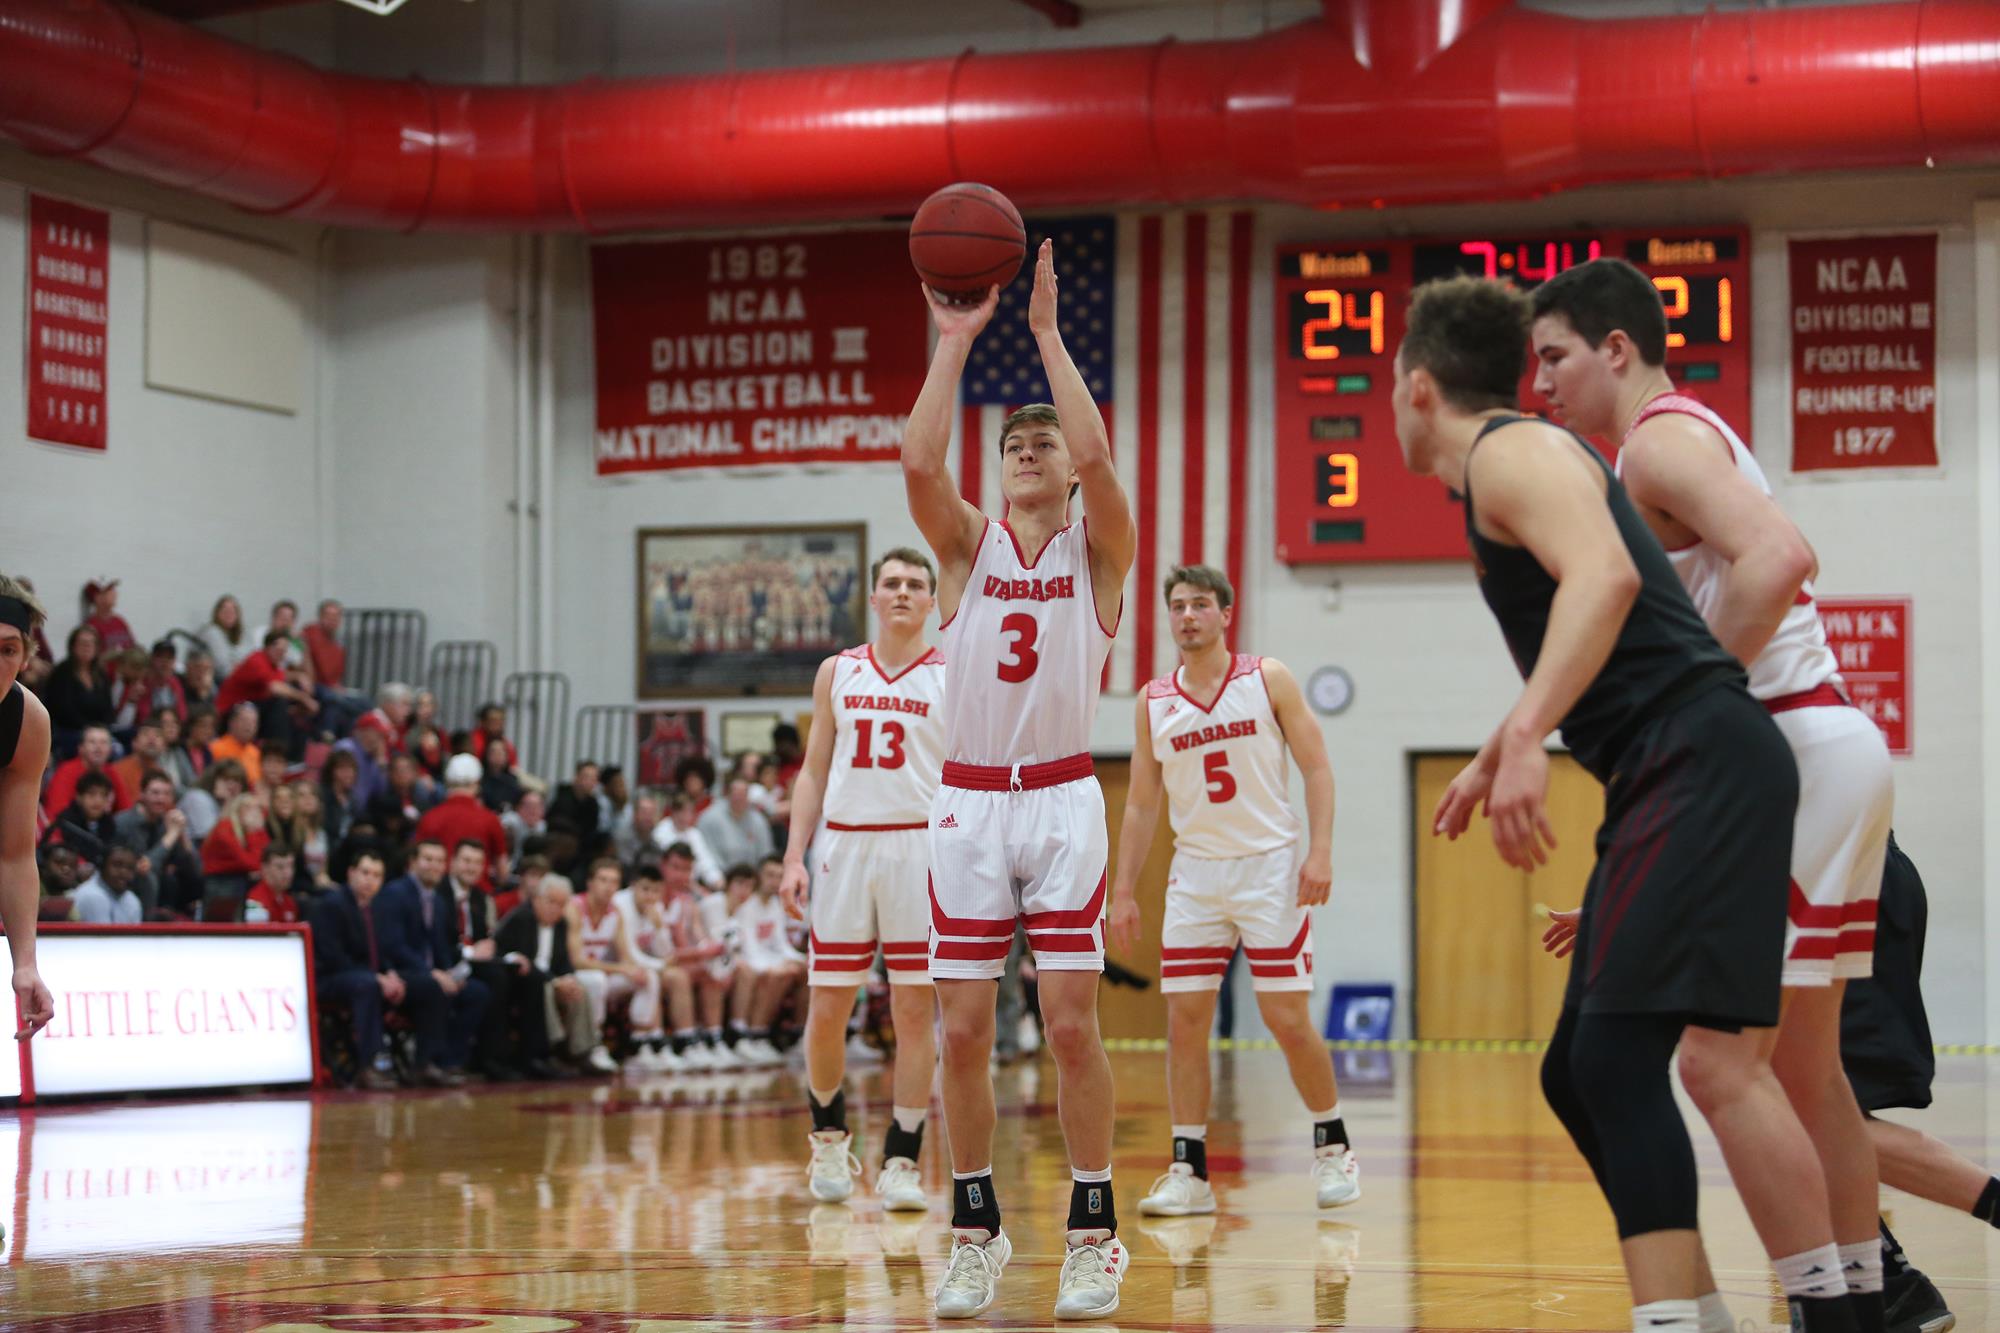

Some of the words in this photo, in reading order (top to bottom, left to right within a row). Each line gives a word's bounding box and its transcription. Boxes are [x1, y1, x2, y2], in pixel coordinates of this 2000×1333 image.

[709, 248, 806, 280] 1982
[1816, 255, 1909, 293] NCAA
[34, 288, 106, 324] BASKETBALL
[709, 289, 804, 324] NCAA
[1302, 289, 1384, 360] 24
[1651, 275, 1732, 348] 21
[1795, 304, 1905, 333] DIVISION
[1909, 302, 1931, 329] III
[41, 326, 103, 356] MIDWEST
[651, 330, 813, 372] DIVISION
[833, 328, 868, 361] III
[1803, 344, 1921, 374] FOOTBALL
[645, 370, 874, 416] BASKETBALL
[1796, 385, 1937, 415] RUNNER-UP
[596, 420, 743, 463] NATIONAL
[750, 414, 909, 452] CHAMPION
[1833, 426, 1896, 455] 1977
[1328, 453, 1359, 508] 3
[996, 612, 1040, 683] 3
[843, 695, 930, 717] WABASH
[851, 718, 906, 770] 13
[1170, 719, 1257, 752] WABASH
[1203, 750, 1237, 804] 5
[174, 986, 298, 1035] GIANTS
